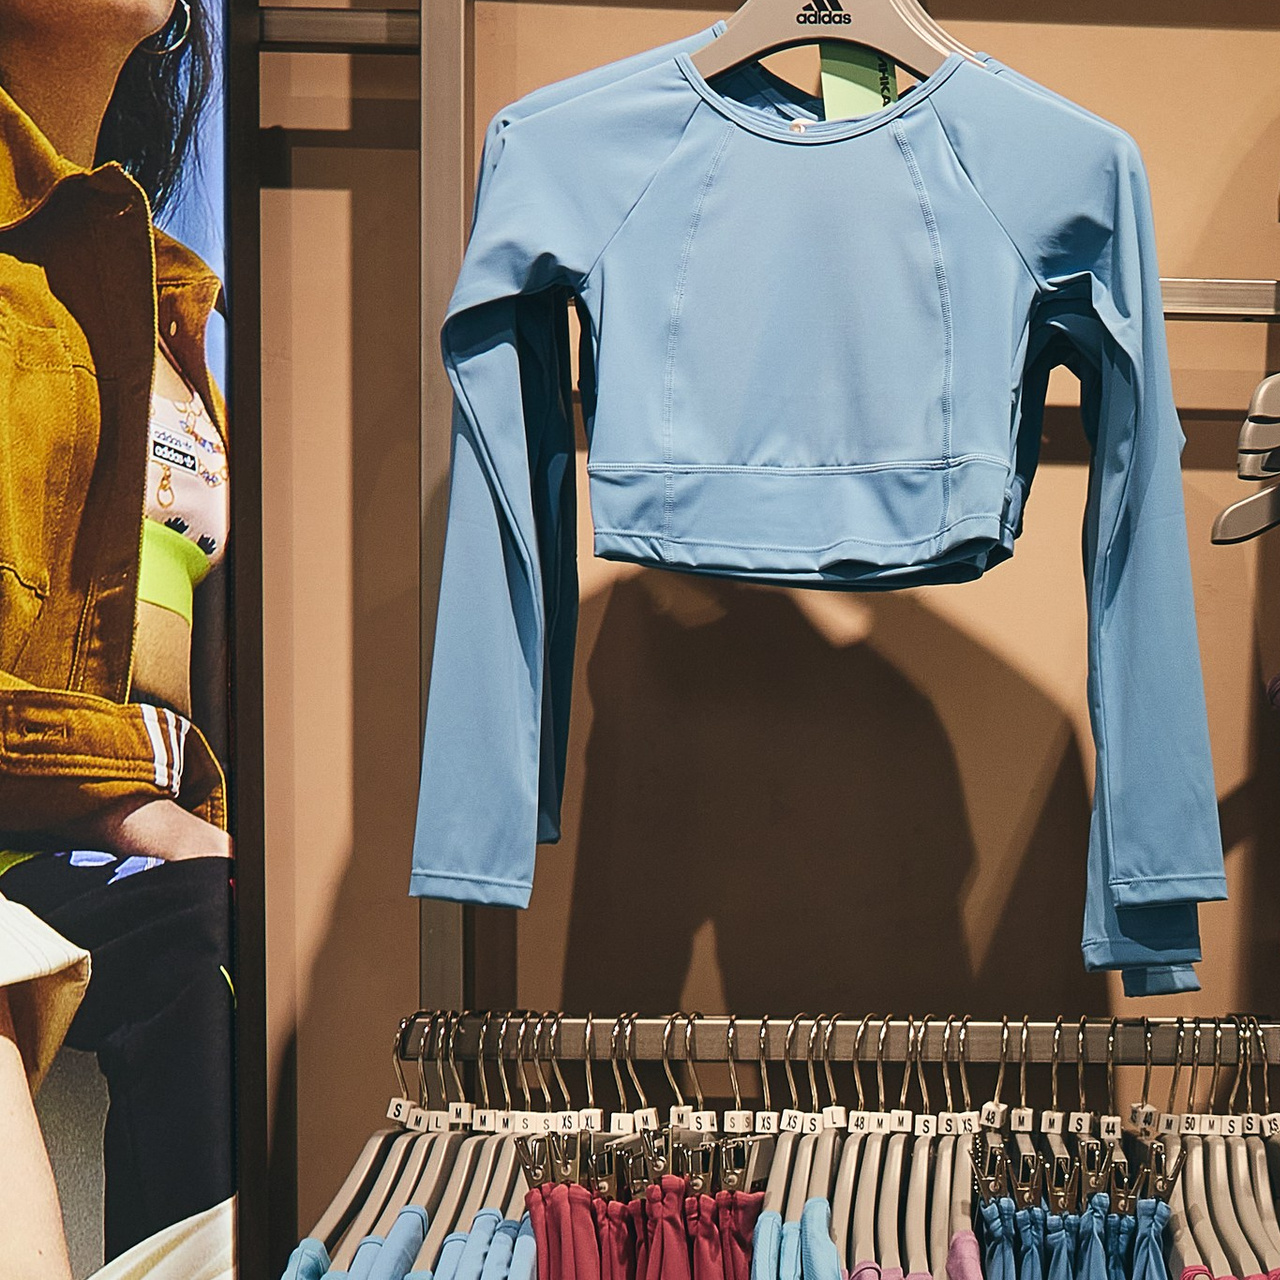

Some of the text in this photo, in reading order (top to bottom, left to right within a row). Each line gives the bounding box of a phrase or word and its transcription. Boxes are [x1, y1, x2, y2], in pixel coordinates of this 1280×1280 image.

[796, 10, 852, 25] adidas
[393, 1104, 402, 1118] S
[455, 1108, 462, 1118] M
[414, 1116, 422, 1127] M
[436, 1117, 441, 1128] L
[480, 1115, 486, 1126] M
[502, 1118, 508, 1129] M
[522, 1118, 528, 1130] S
[544, 1118, 550, 1130] S
[562, 1116, 572, 1129] XS
[585, 1116, 594, 1129] XL
[618, 1119, 623, 1130] L
[642, 1116, 649, 1126] M
[677, 1113, 684, 1124] M
[696, 1117, 702, 1130] S
[730, 1117, 736, 1128] S
[761, 1116, 771, 1129] XS
[786, 1114, 797, 1128] XS
[831, 1112, 837, 1125] L
[854, 1116, 864, 1130] 48
[877, 1118, 883, 1129] M
[898, 1116, 904, 1127] M
[985, 1111, 995, 1125] 48
[1018, 1116, 1024, 1126] M
[1048, 1118, 1054, 1129] M
[1165, 1118, 1173, 1130] M
[1185, 1116, 1196, 1130] 50
[1246, 1116, 1253, 1130] S
[809, 1118, 816, 1132] S
[922, 1120, 930, 1133] S
[945, 1118, 952, 1132] S
[963, 1118, 972, 1133] XS
[1075, 1118, 1083, 1132] S
[1105, 1122, 1116, 1135] 44
[1208, 1120, 1215, 1130] M
[1228, 1120, 1235, 1133] S
[1270, 1118, 1279, 1132] XS
